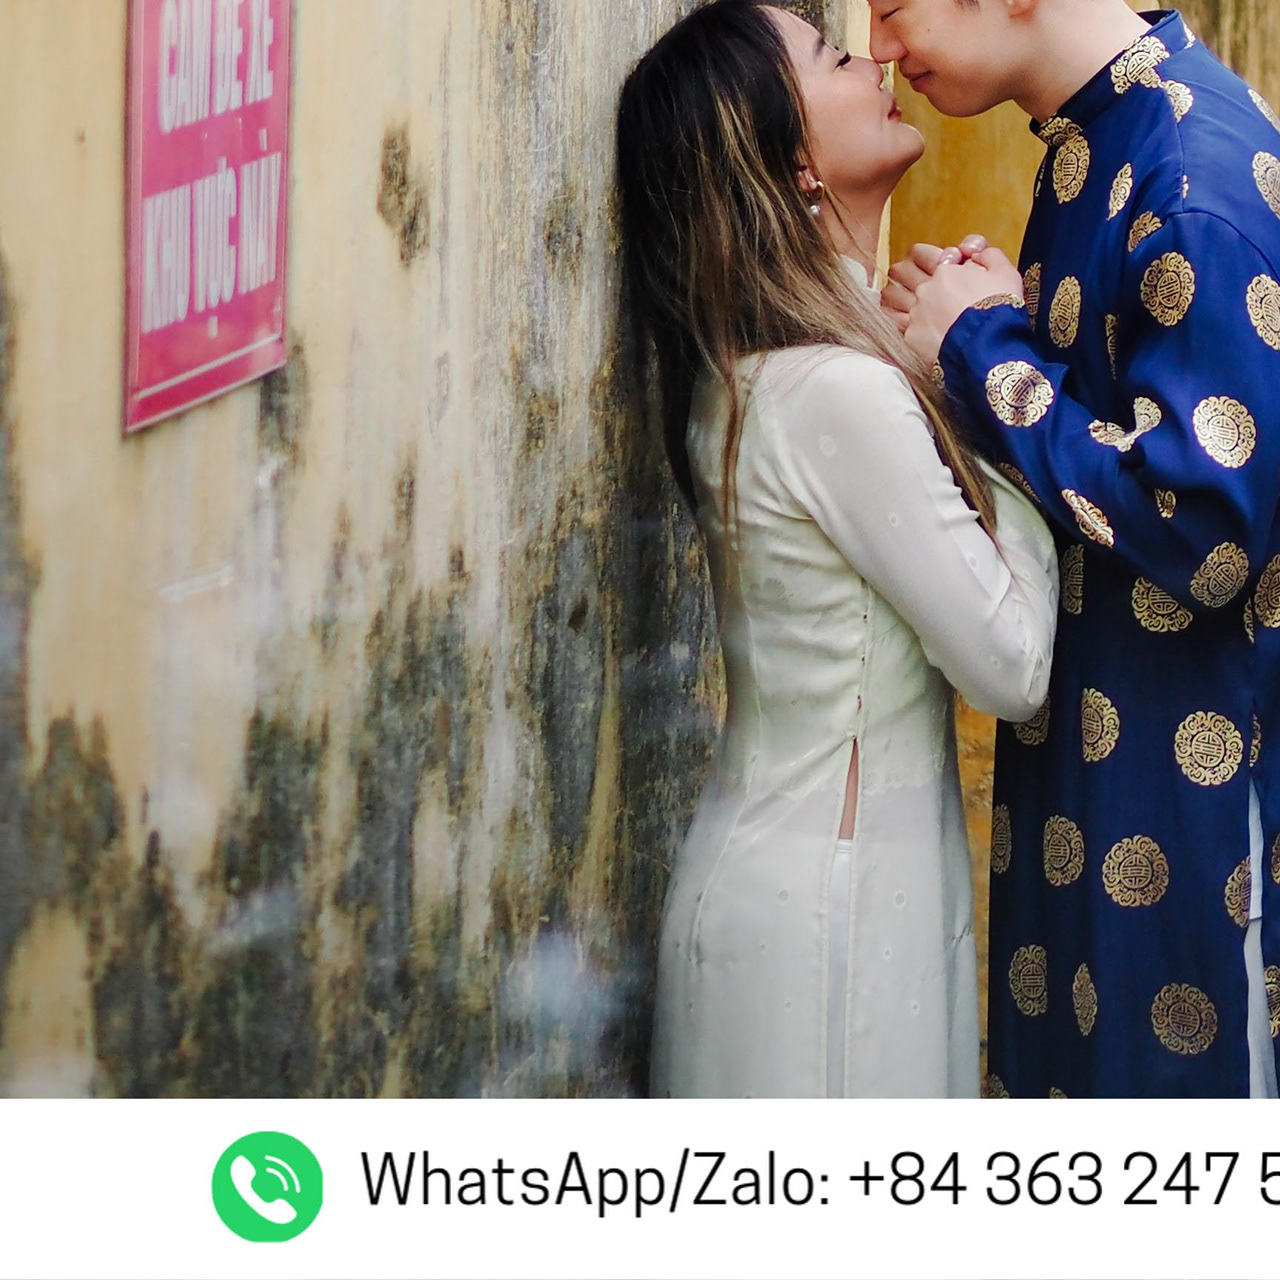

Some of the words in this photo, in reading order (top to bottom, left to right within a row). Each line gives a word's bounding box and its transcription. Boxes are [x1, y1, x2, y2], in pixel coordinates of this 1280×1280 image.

[142, 183, 191, 334] KHU
[193, 156, 237, 339] VỰC
[239, 128, 282, 295] NÀY
